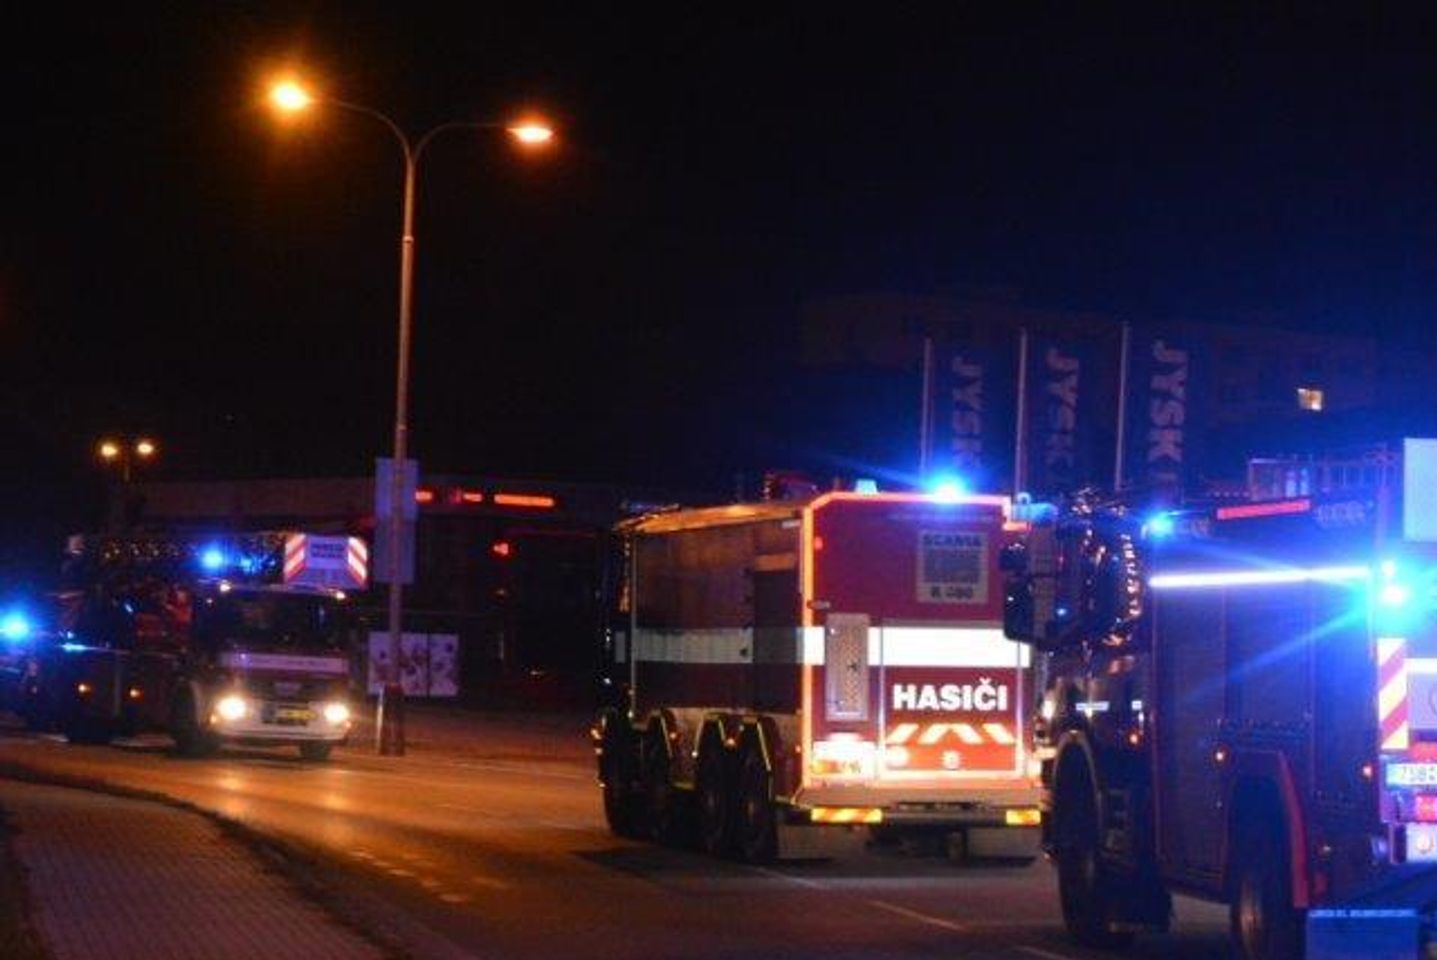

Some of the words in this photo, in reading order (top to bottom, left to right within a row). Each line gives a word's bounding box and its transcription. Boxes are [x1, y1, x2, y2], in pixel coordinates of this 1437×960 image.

[1047, 348, 1080, 467] JYSK
[1148, 340, 1188, 463] JYSK
[892, 676, 1009, 712] HASIČI
